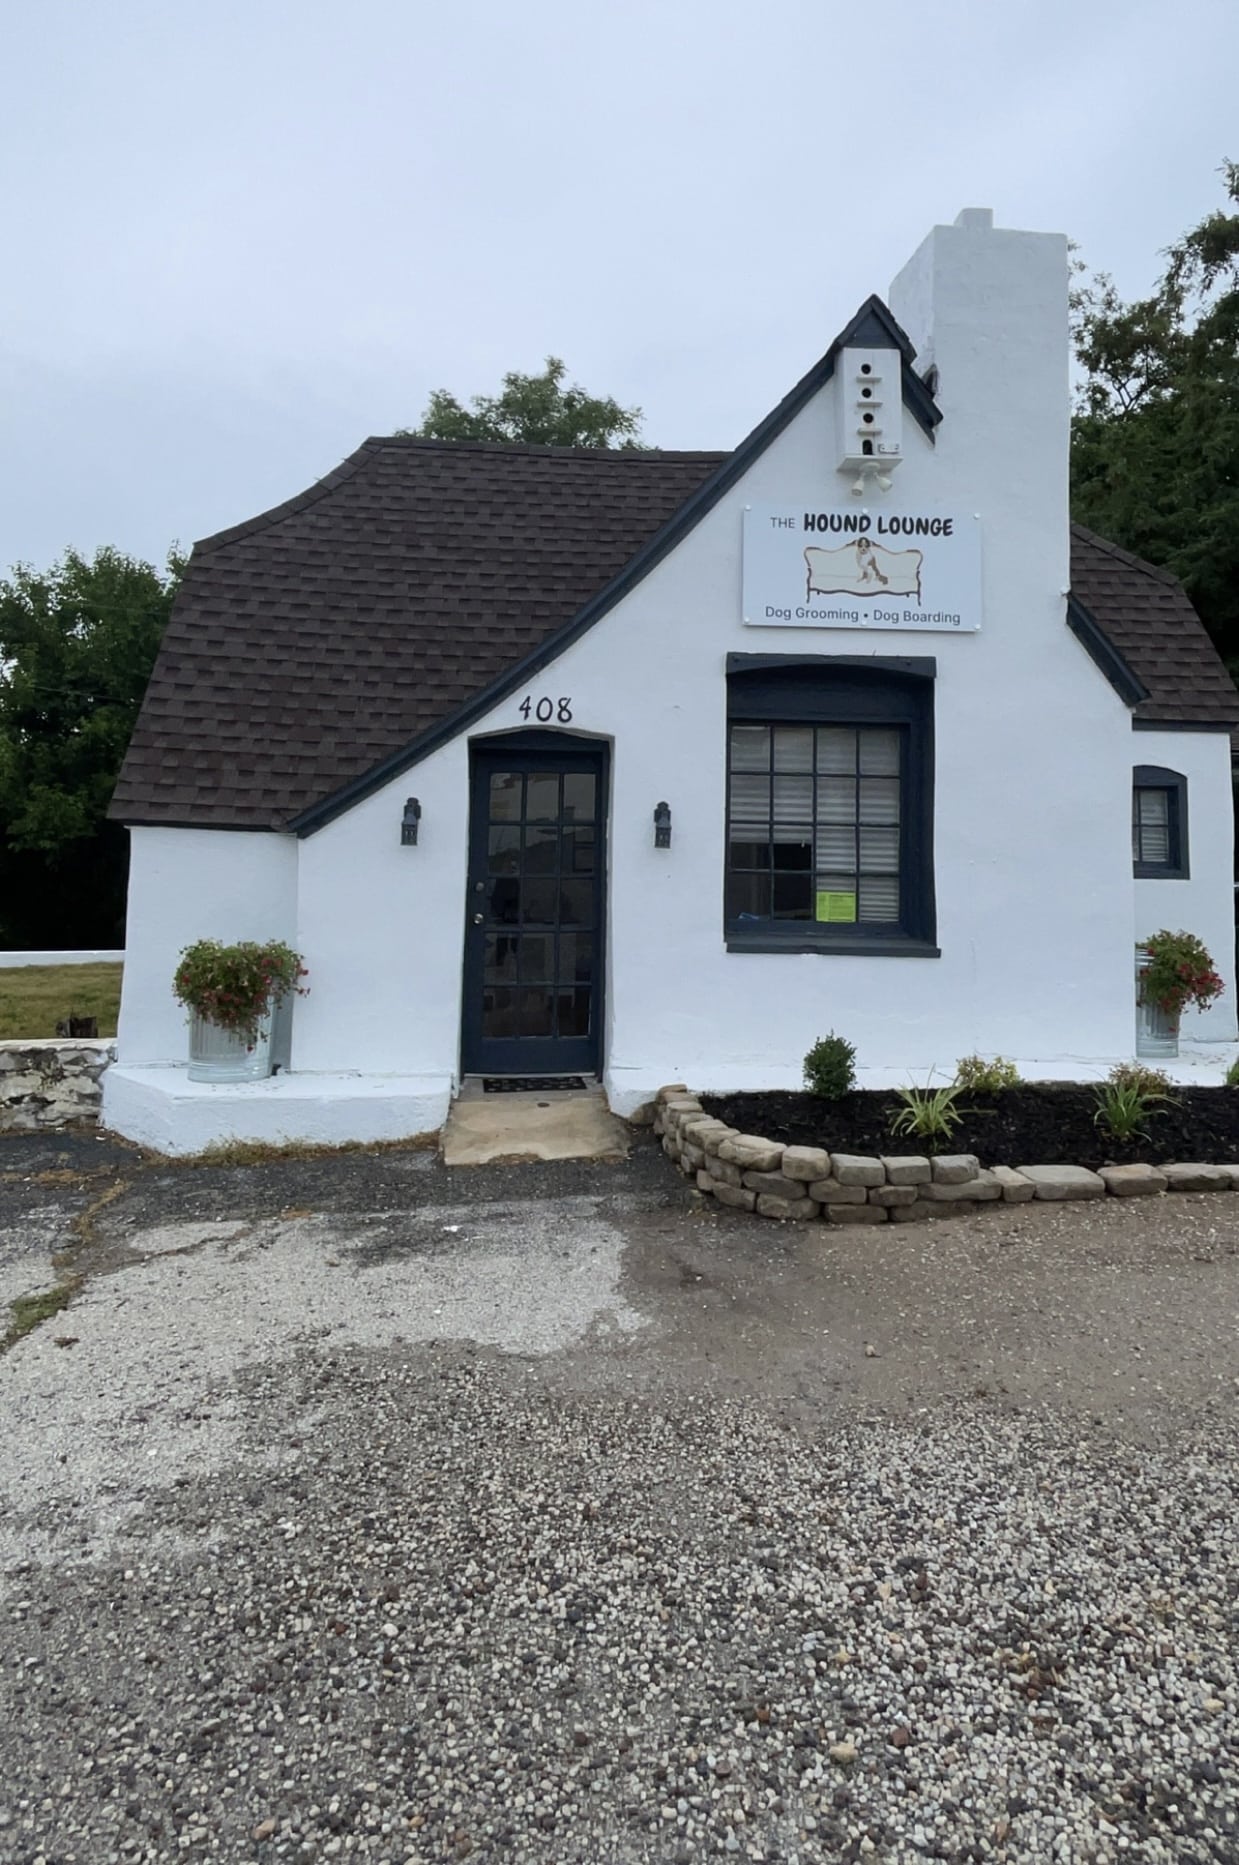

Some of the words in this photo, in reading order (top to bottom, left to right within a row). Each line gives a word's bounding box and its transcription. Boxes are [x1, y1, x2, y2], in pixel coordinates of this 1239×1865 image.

[770, 517, 796, 529] THE
[803, 513, 871, 533] HOUND
[877, 516, 954, 537] LOUNGE
[765, 606, 791, 620] Dog
[795, 607, 859, 622] Grooming
[873, 609, 900, 623] Dog
[903, 610, 961, 625] Boarding
[519, 696, 572, 723] 408
